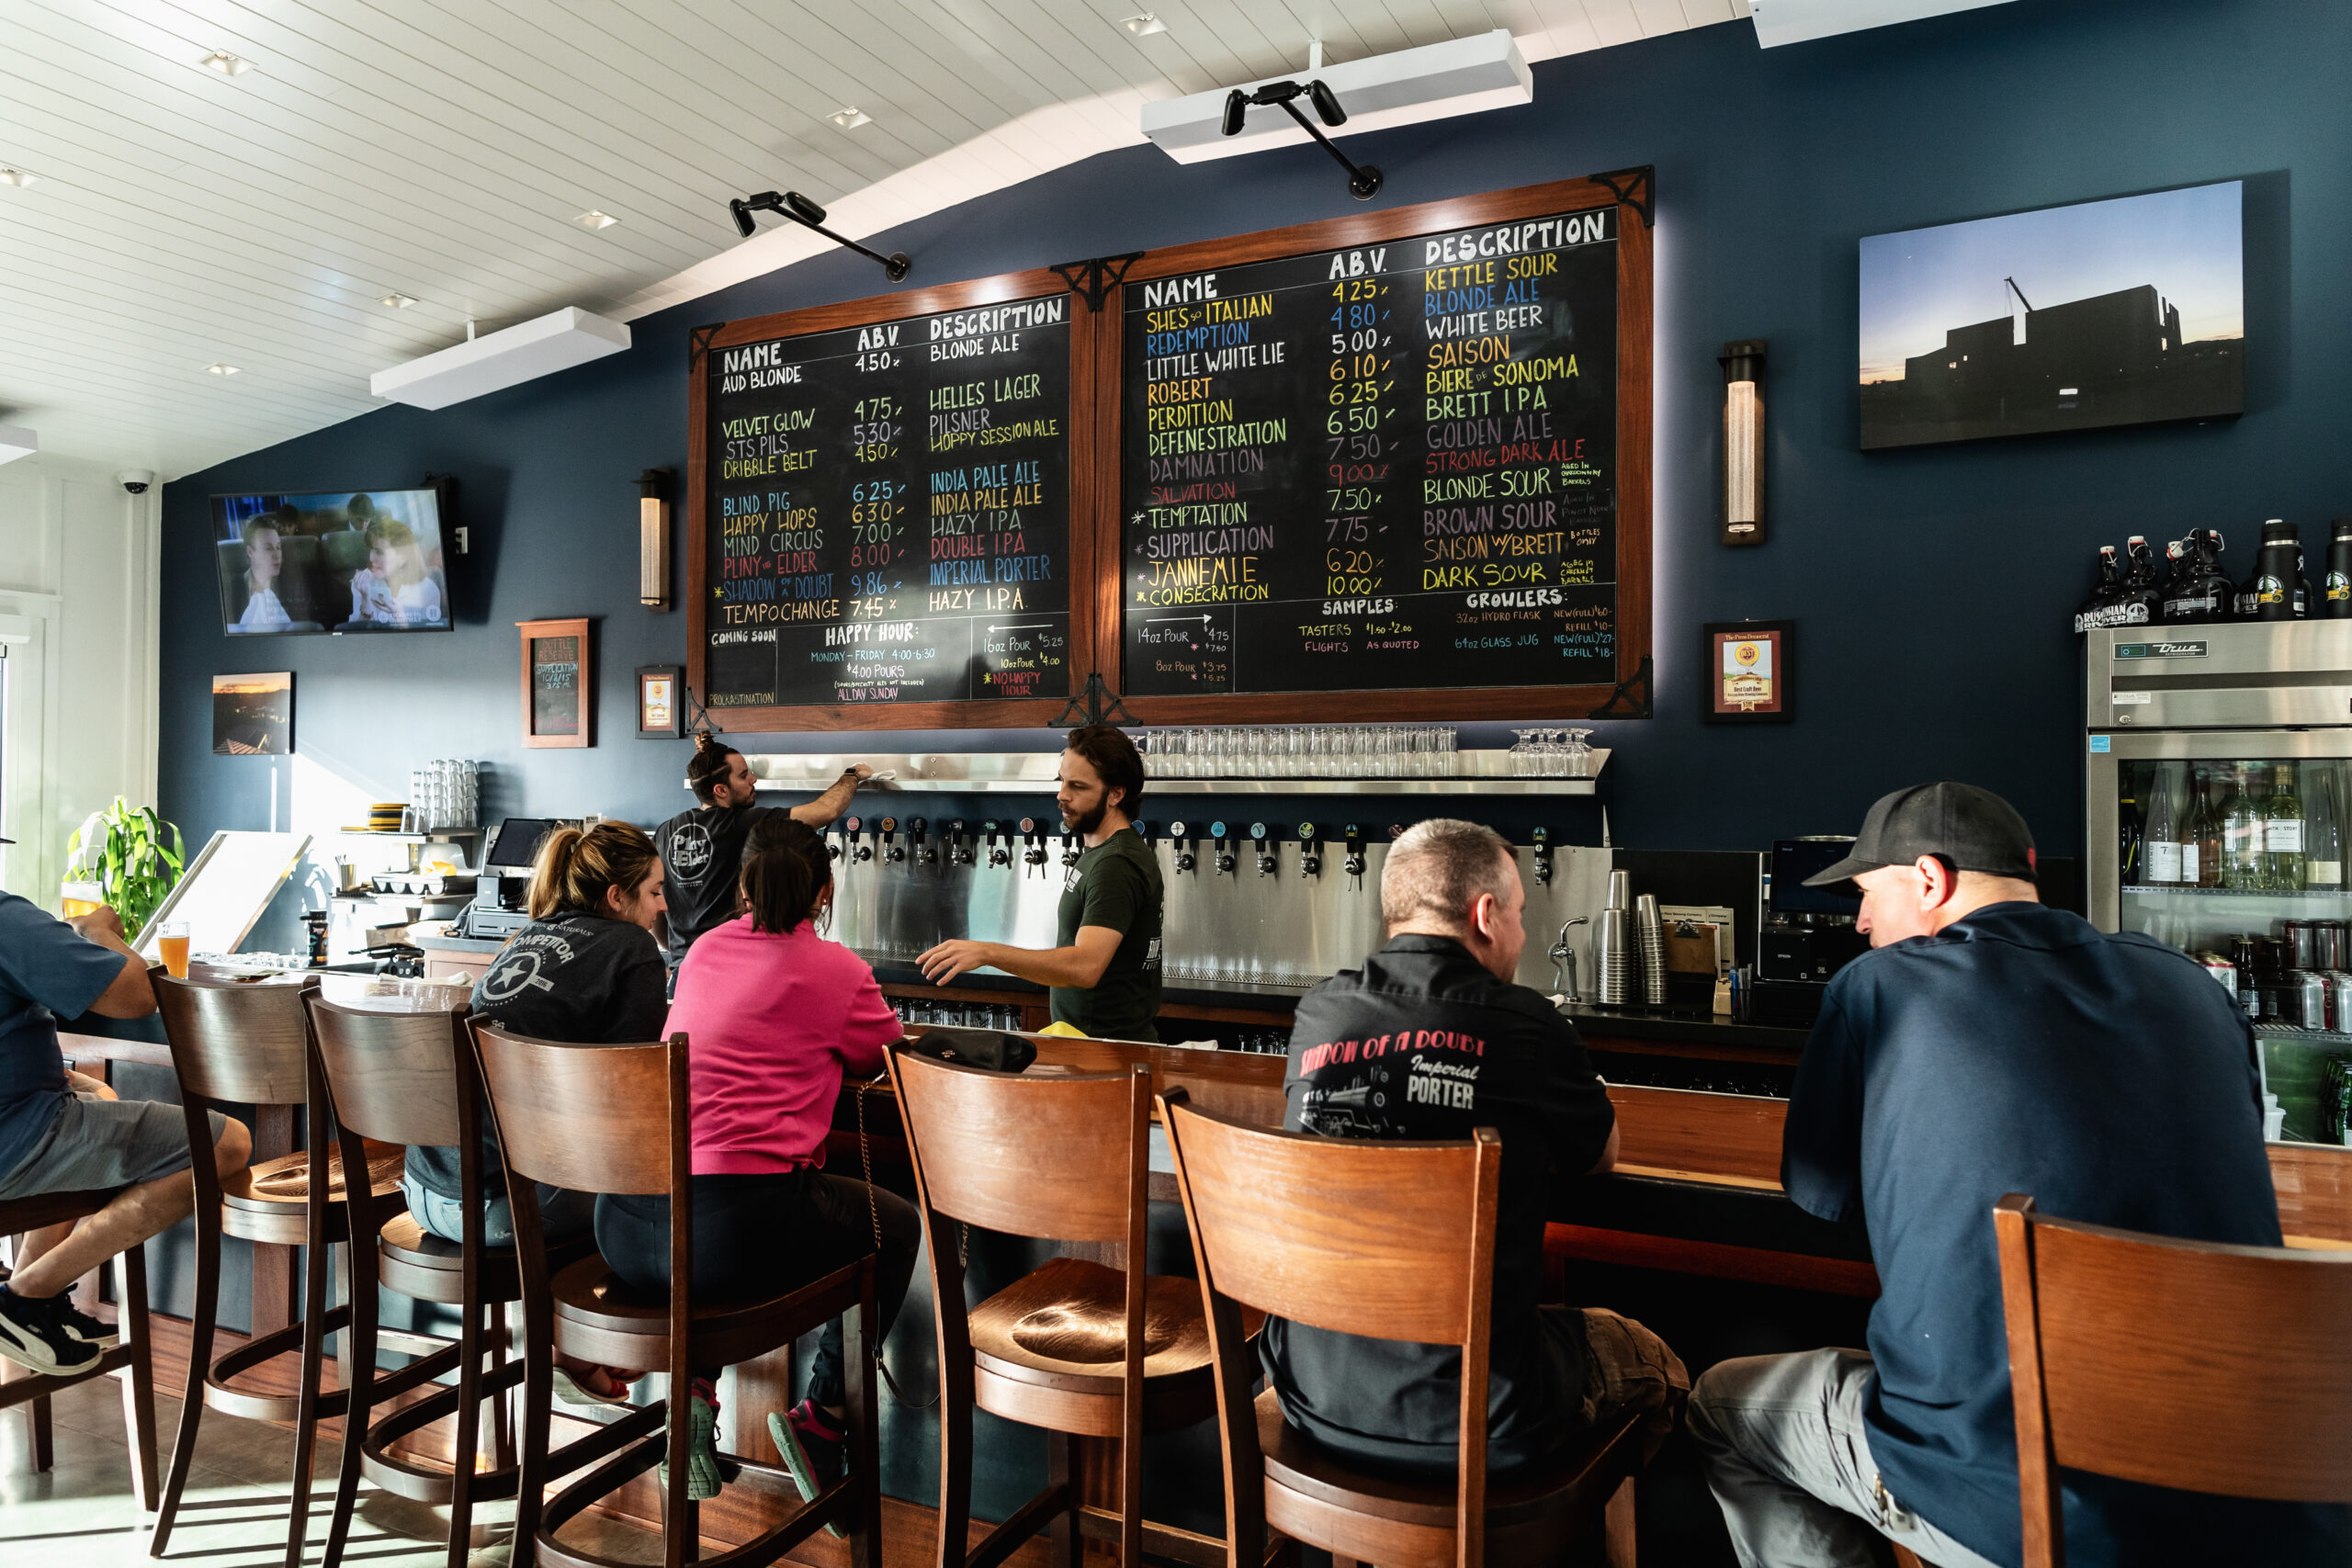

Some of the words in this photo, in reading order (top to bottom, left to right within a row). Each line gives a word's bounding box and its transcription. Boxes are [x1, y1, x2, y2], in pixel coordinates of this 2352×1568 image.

[1426, 211, 1605, 266] DESCRIPTION
[1329, 247, 1387, 280] A.B.V.
[1424, 263, 1496, 292] KETTLE
[1507, 254, 1558, 279] SOUR
[1144, 274, 1218, 309] NAME
[1424, 287, 1496, 319] BLONDE
[1504, 277, 1540, 304] ALE
[930, 299, 1063, 341] DESCRIPTION
[1146, 309, 1190, 333] SHE'S
[1205, 294, 1272, 323] ITALIAN
[1425, 313, 1491, 341] WHITE
[1497, 306, 1544, 331] BEER
[930, 338, 984, 362] BLONDE
[991, 334, 1021, 354] ALE
[1147, 321, 1250, 359] REDEMPTION
[1428, 333, 1510, 369] SAISON
[724, 343, 781, 373] NAME
[1147, 355, 1199, 382] LITTLE
[1204, 346, 1258, 375] WHITE
[1262, 341, 1285, 366] LIE
[722, 376, 747, 394] AUD
[751, 366, 802, 388] BLONDE
[1425, 367, 1475, 395] BIERE
[1493, 355, 1579, 388] SONOMA
[930, 382, 985, 411] HELLES
[994, 374, 1041, 402] LAGER
[1147, 378, 1213, 406] ROBERT
[1425, 391, 1490, 422] BRETT
[723, 415, 770, 439] VELVET
[775, 408, 816, 433] GLOW
[930, 409, 990, 436] PILSNER
[1148, 400, 1233, 433] PERDITION
[931, 431, 977, 454] HOPPY
[979, 422, 1032, 446] SESSION
[1033, 419, 1060, 437] ALE
[1148, 418, 1286, 457] DEFENESTRATION
[1426, 419, 1502, 451] GOLDEN
[1511, 412, 1553, 441] ALE
[727, 436, 756, 460] STS
[760, 434, 788, 456] PILS
[1425, 447, 1497, 475] STRONG
[1500, 445, 1546, 468] DARK
[1549, 437, 1586, 462] ALE
[724, 456, 779, 479] DRIBBLE
[783, 449, 818, 471] BELT
[931, 467, 969, 493] INDIA
[973, 463, 1009, 489] PALE
[1014, 460, 1040, 484] ALE
[1148, 447, 1264, 483] DAMNATION
[932, 492, 971, 516] INDIA
[974, 489, 1010, 512] PALE
[1013, 483, 1043, 508] ALE
[1148, 481, 1236, 506] SALVATION
[1423, 474, 1495, 504] BLONDE
[1499, 467, 1552, 496] SOUR
[723, 496, 761, 517] BLIND
[767, 491, 790, 513] PIG
[1148, 501, 1248, 530] TEMPTATION
[1423, 508, 1498, 536] BROWN
[1500, 501, 1558, 530] SOUR
[723, 513, 769, 537] HAPPY
[776, 507, 817, 533] HOPS
[932, 514, 980, 537] HAZY
[723, 534, 761, 558] MIND
[770, 528, 823, 552] CIRCUS
[931, 536, 985, 559] DOUBLE
[1147, 525, 1273, 558] SUPPLICATION
[1423, 533, 1488, 562] SAISON
[723, 556, 762, 579] PLINY
[777, 552, 818, 574] ELDER
[930, 559, 993, 586] IMPERIAL
[995, 555, 1052, 581] PORTER
[1148, 556, 1259, 588] JANNEMIE
[1423, 565, 1478, 591] DARK
[1483, 563, 1547, 586] SOUR
[723, 578, 776, 602] SHADOW
[781, 577, 792, 585] OF
[795, 573, 834, 599] DOUBT
[929, 588, 976, 612] HAZY
[1148, 583, 1270, 606] CONSECRATION
[1466, 589, 1568, 608] GROWLERS:
[1322, 598, 1398, 615] SAMPLES:
[1481, 611, 1511, 622] HYDRO
[1513, 610, 1542, 621] FLASK
[711, 630, 749, 646] COMING
[752, 628, 776, 642] SOON
[825, 623, 873, 647] HAPPY
[878, 622, 919, 642] HOUR:
[1164, 628, 1190, 643] POUR
[1298, 624, 1351, 637] TASTERS
[1480, 636, 1512, 648] GLASS
[1517, 634, 1539, 647] JUG
[1566, 623, 1591, 632] REFILL
[810, 650, 846, 662] MONDAY
[854, 649, 886, 661] FRIDAY
[1009, 637, 1032, 651] POUR
[1305, 641, 1349, 652] FLIGHTS
[1366, 640, 1379, 649] AS
[1382, 640, 1419, 649] QUOTED
[1563, 648, 1592, 658] REFILL
[874, 664, 905, 678] POURS
[1017, 657, 1035, 669] POUR
[1175, 660, 1196, 672] POUR
[993, 671, 1008, 685] NO
[1009, 671, 1042, 684] HAPPY
[1001, 685, 1032, 696] HOUR
[838, 689, 853, 702] ALL
[853, 688, 866, 703] DAY
[870, 687, 899, 702] SUNDAY
[1363, 1034, 1390, 1060] OF
[1414, 1030, 1487, 1056] DOUBT
[1410, 1055, 1479, 1080] Imperial
[1407, 1075, 1475, 1110] PORTER
